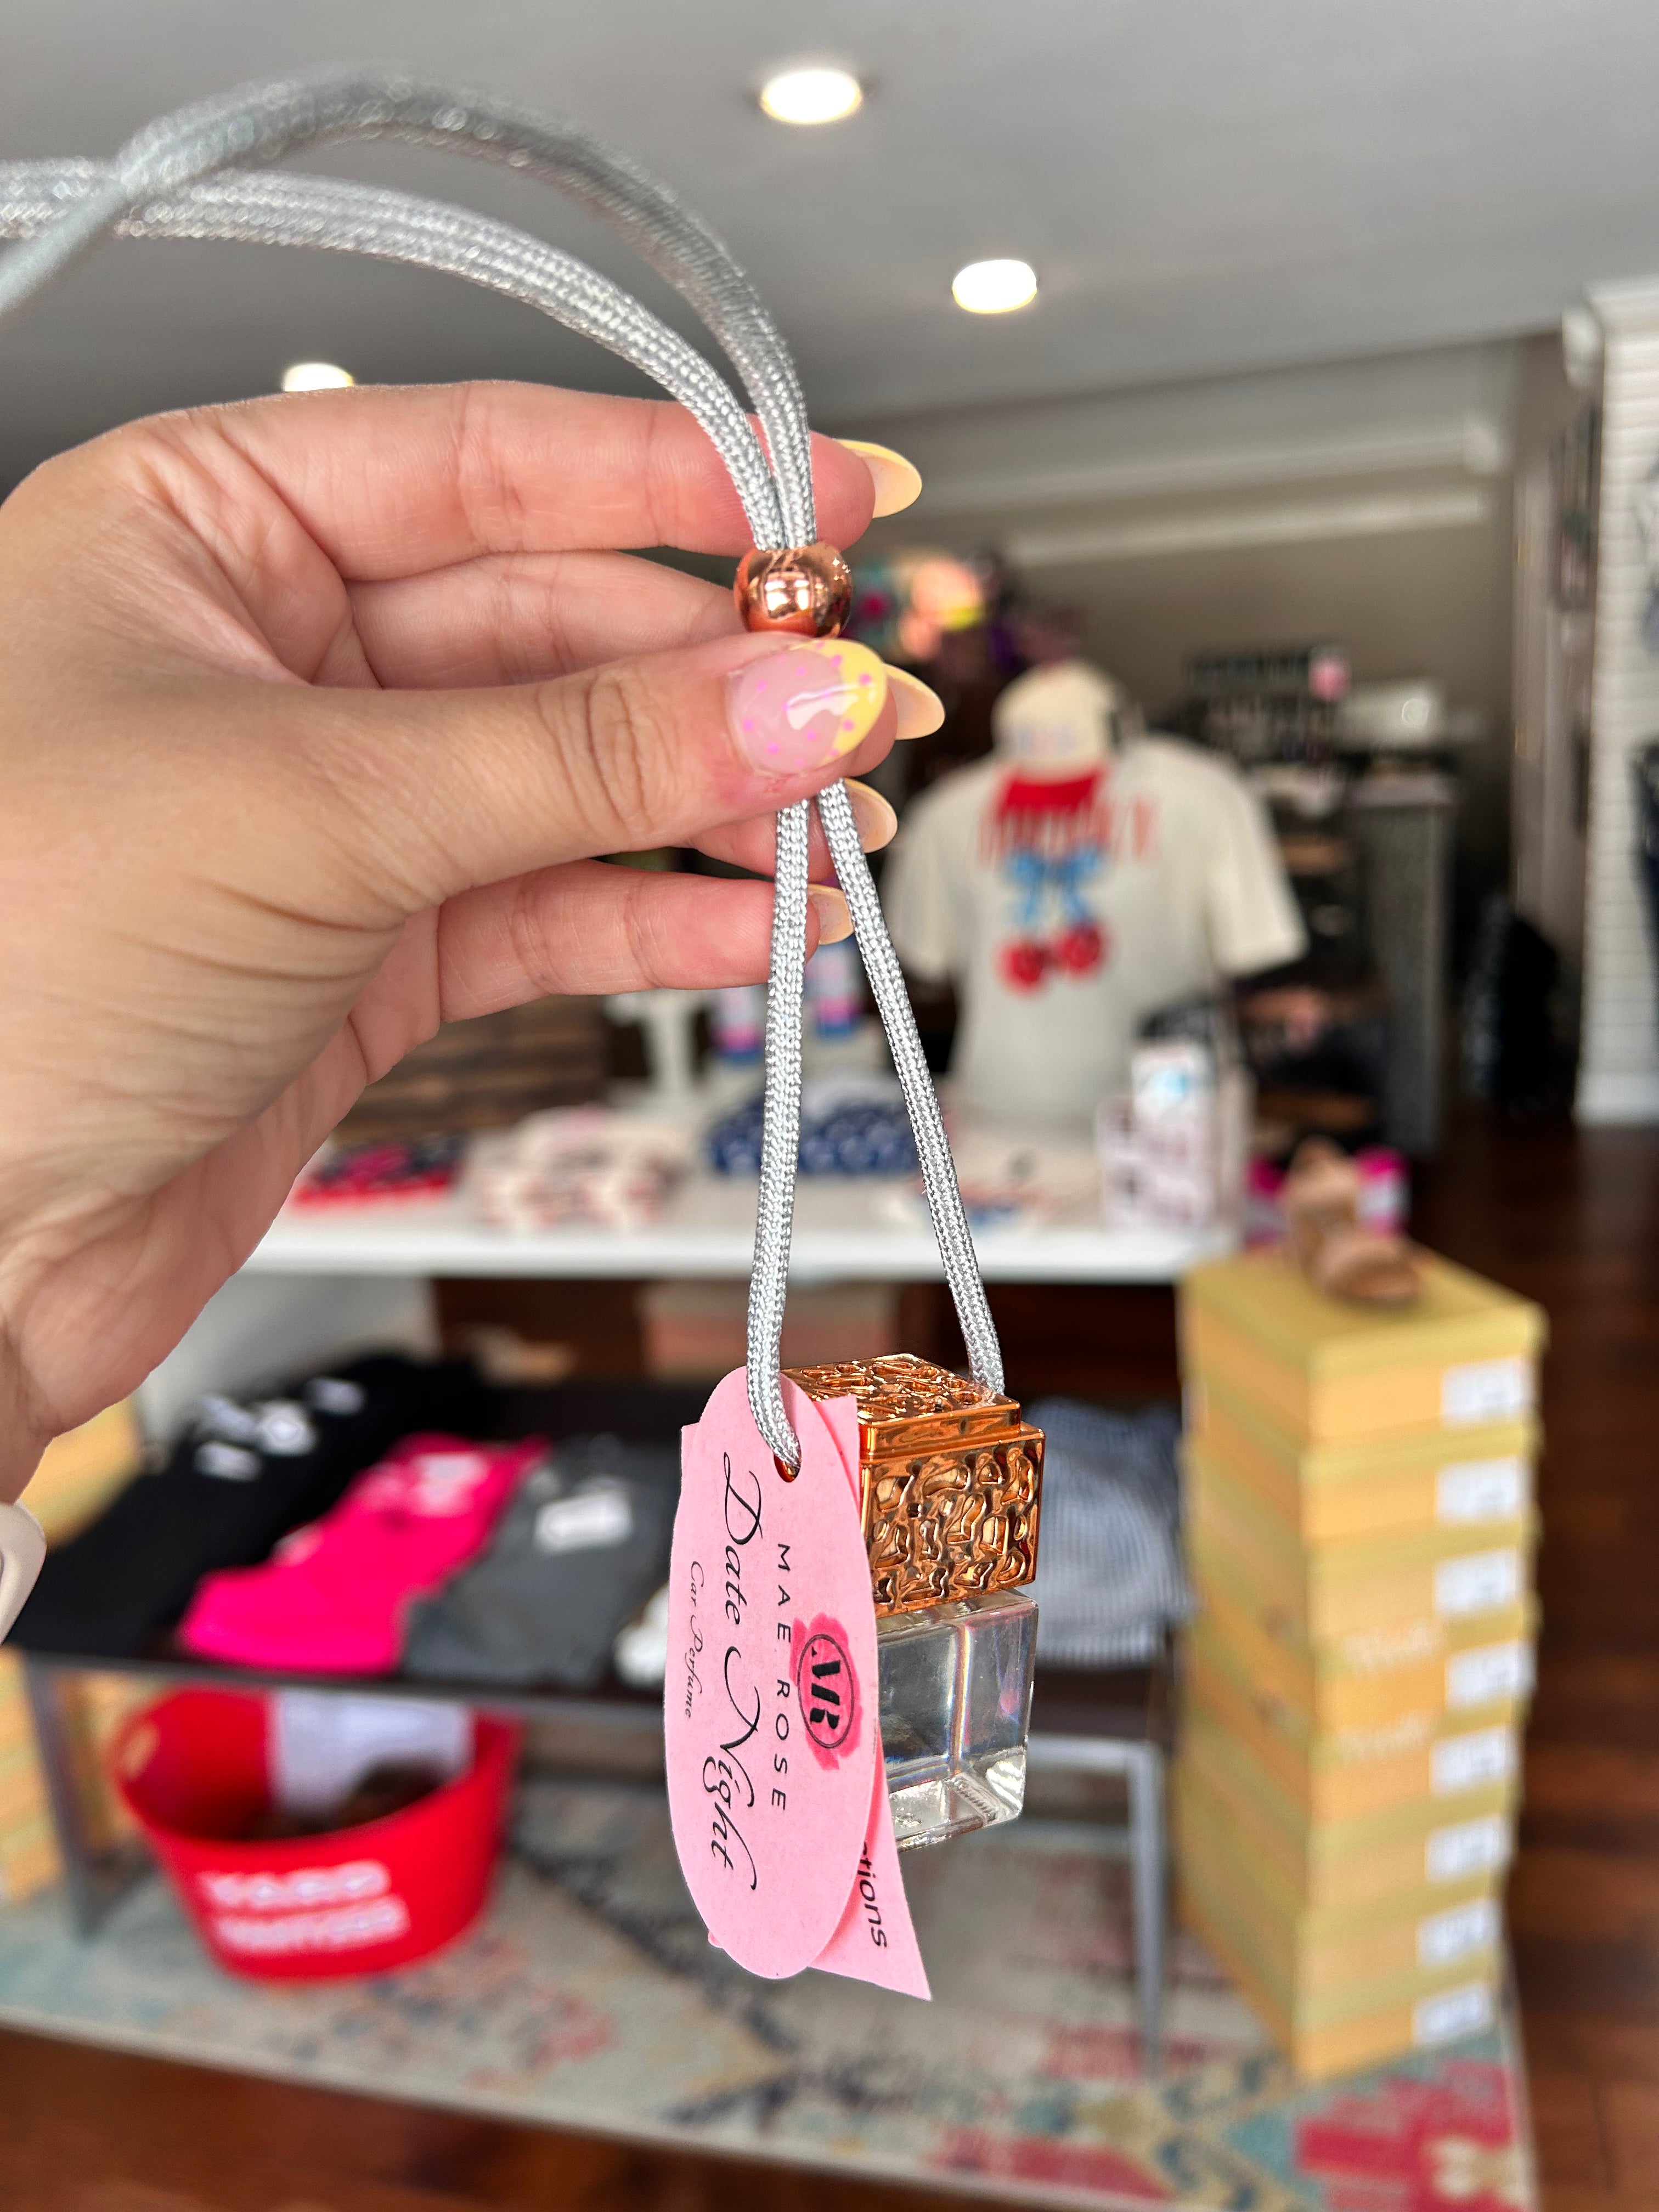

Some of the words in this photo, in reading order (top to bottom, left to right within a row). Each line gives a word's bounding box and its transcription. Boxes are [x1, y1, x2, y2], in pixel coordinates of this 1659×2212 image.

[689, 1561, 704, 1607] Car
[723, 1452, 763, 1625] Date
[777, 1543, 792, 1644] MAE
[684, 1615, 703, 1719] Perfume
[703, 1645, 761, 1891] Night
[772, 1679, 791, 1811] ROSE
[857, 1841, 888, 1949] tions
